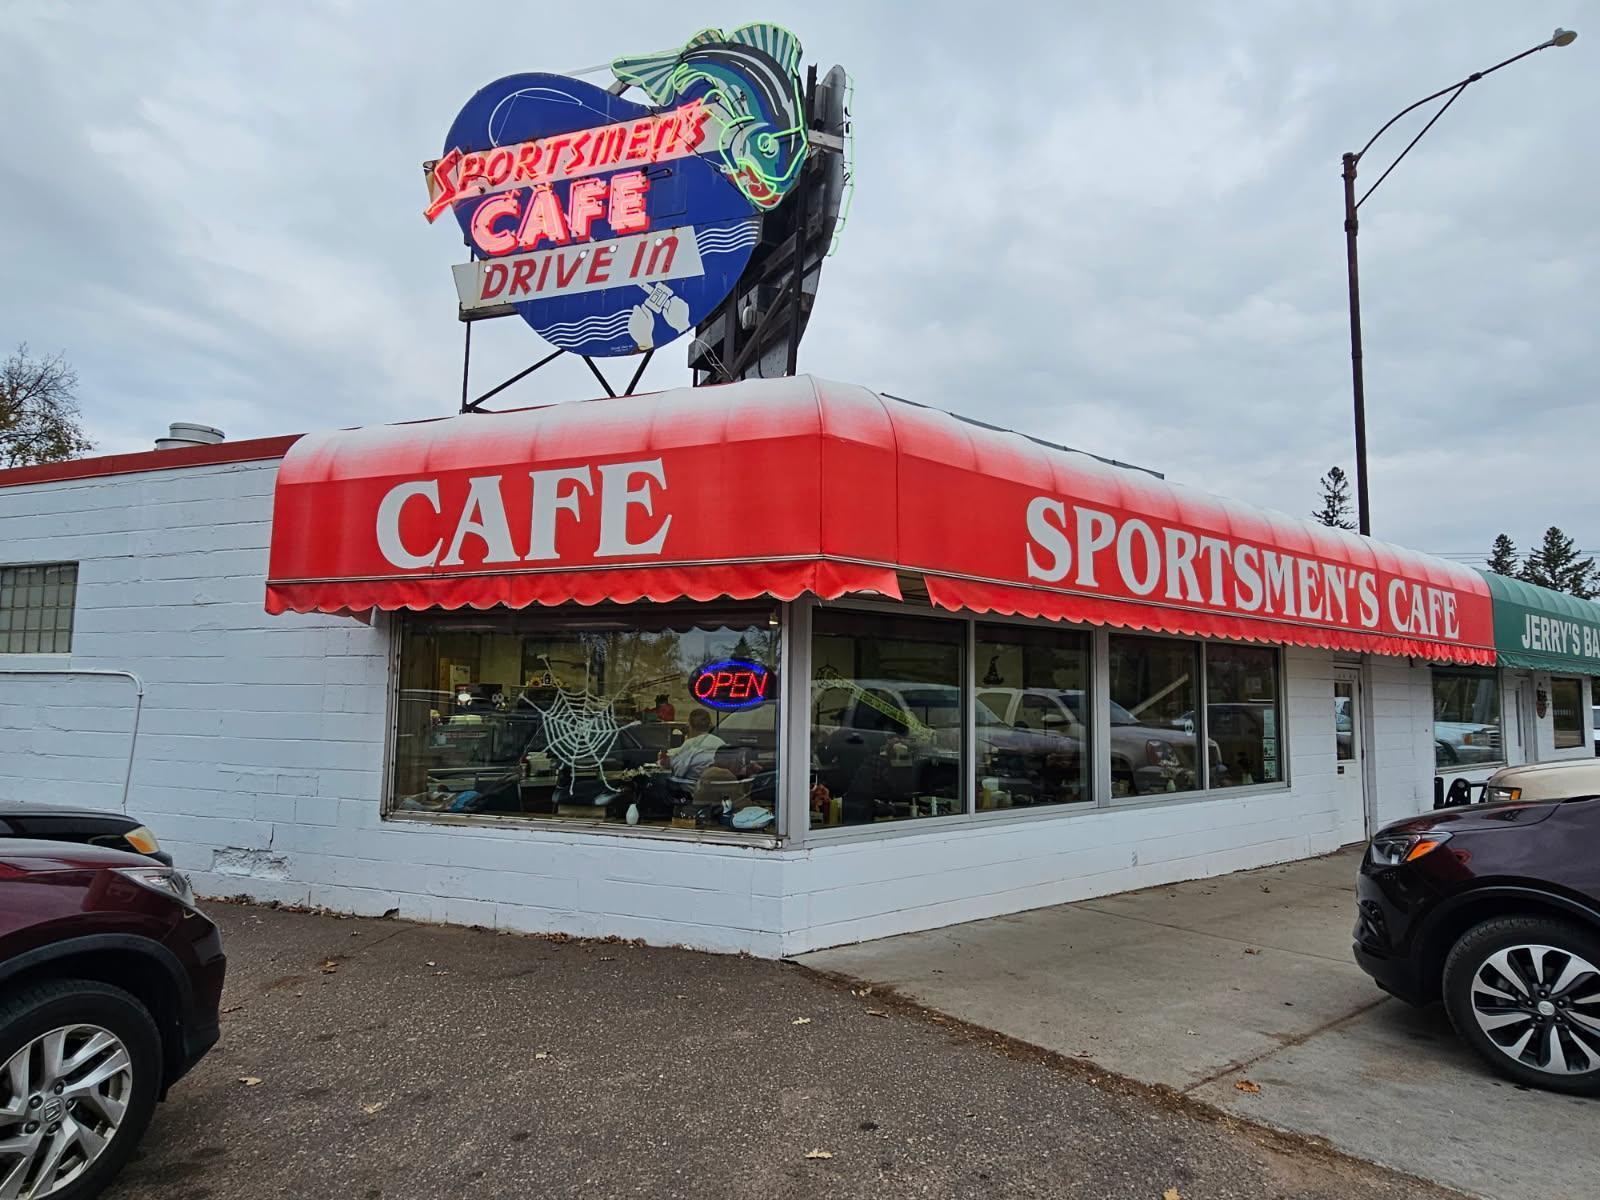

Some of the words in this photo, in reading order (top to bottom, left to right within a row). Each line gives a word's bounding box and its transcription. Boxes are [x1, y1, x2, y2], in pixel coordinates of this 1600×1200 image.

[471, 170, 649, 258] CAFE
[480, 243, 614, 301] DRIVE
[375, 457, 673, 570] CAFE
[1025, 496, 1380, 628] SPORTSMEN'S
[1387, 578, 1460, 640] CAFE
[1521, 613, 1581, 656] JERRY'S
[1583, 625, 1600, 658] BA
[695, 671, 769, 698] OPEN
